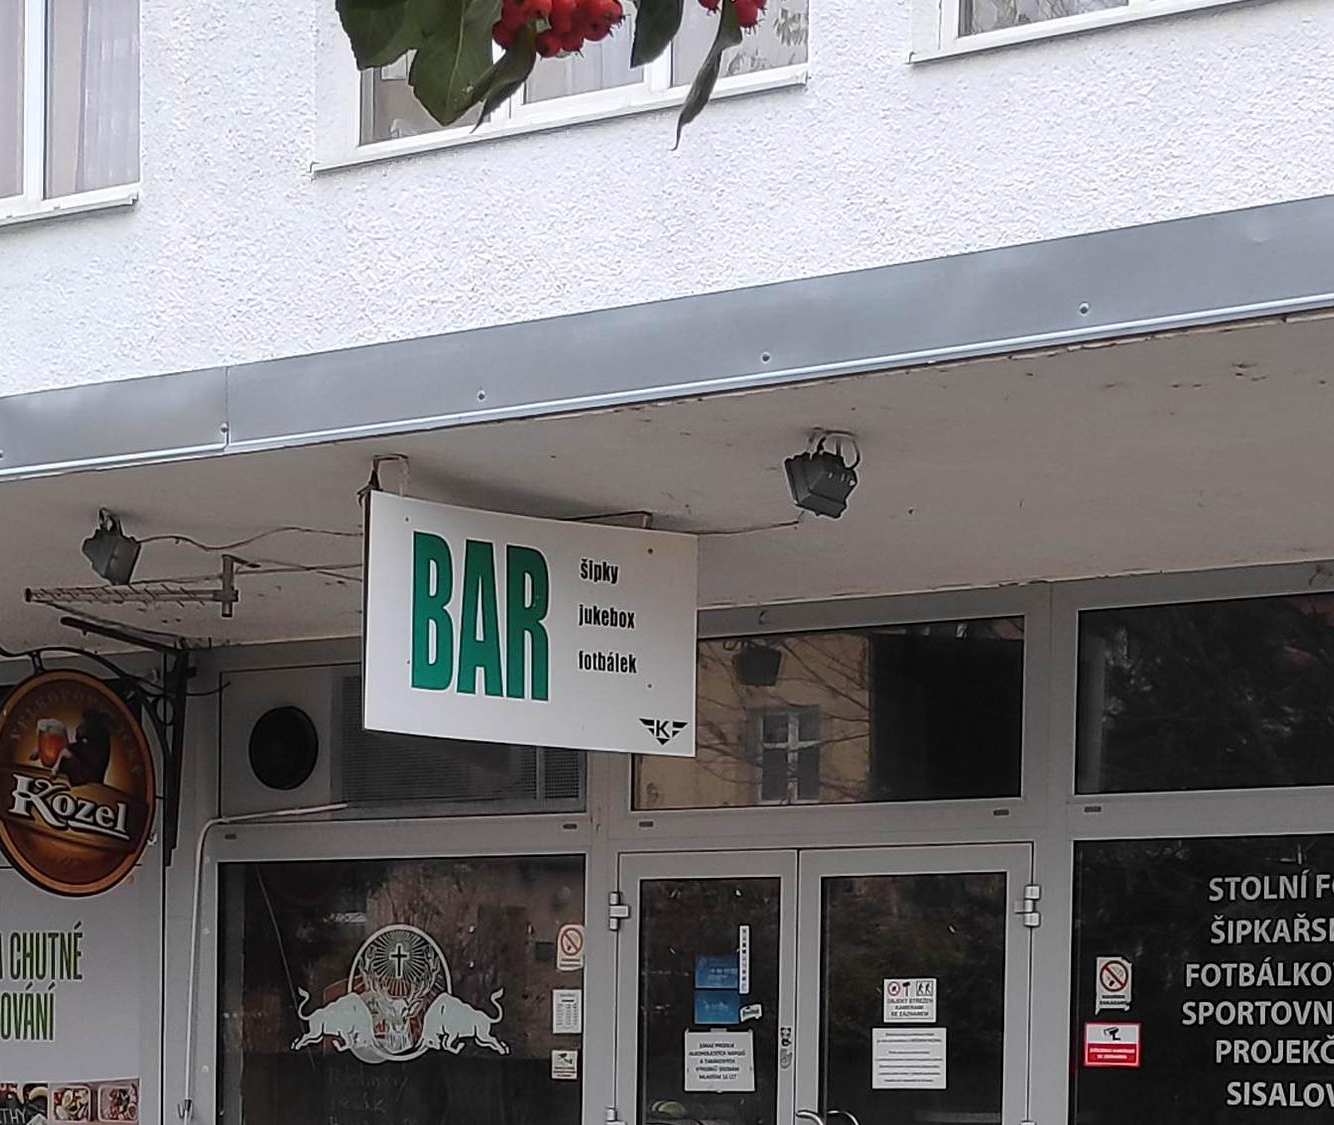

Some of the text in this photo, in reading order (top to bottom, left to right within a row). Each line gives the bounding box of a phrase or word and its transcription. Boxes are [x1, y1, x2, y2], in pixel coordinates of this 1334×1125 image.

[580, 558, 619, 584] šipky
[411, 530, 549, 702] BAR
[578, 604, 636, 629] jukebox
[578, 650, 637, 674] fotbálek
[9, 774, 130, 836] Kozel
[1209, 869, 1310, 901] STOLNÍ
[10, 921, 83, 980] CHUTNÉ
